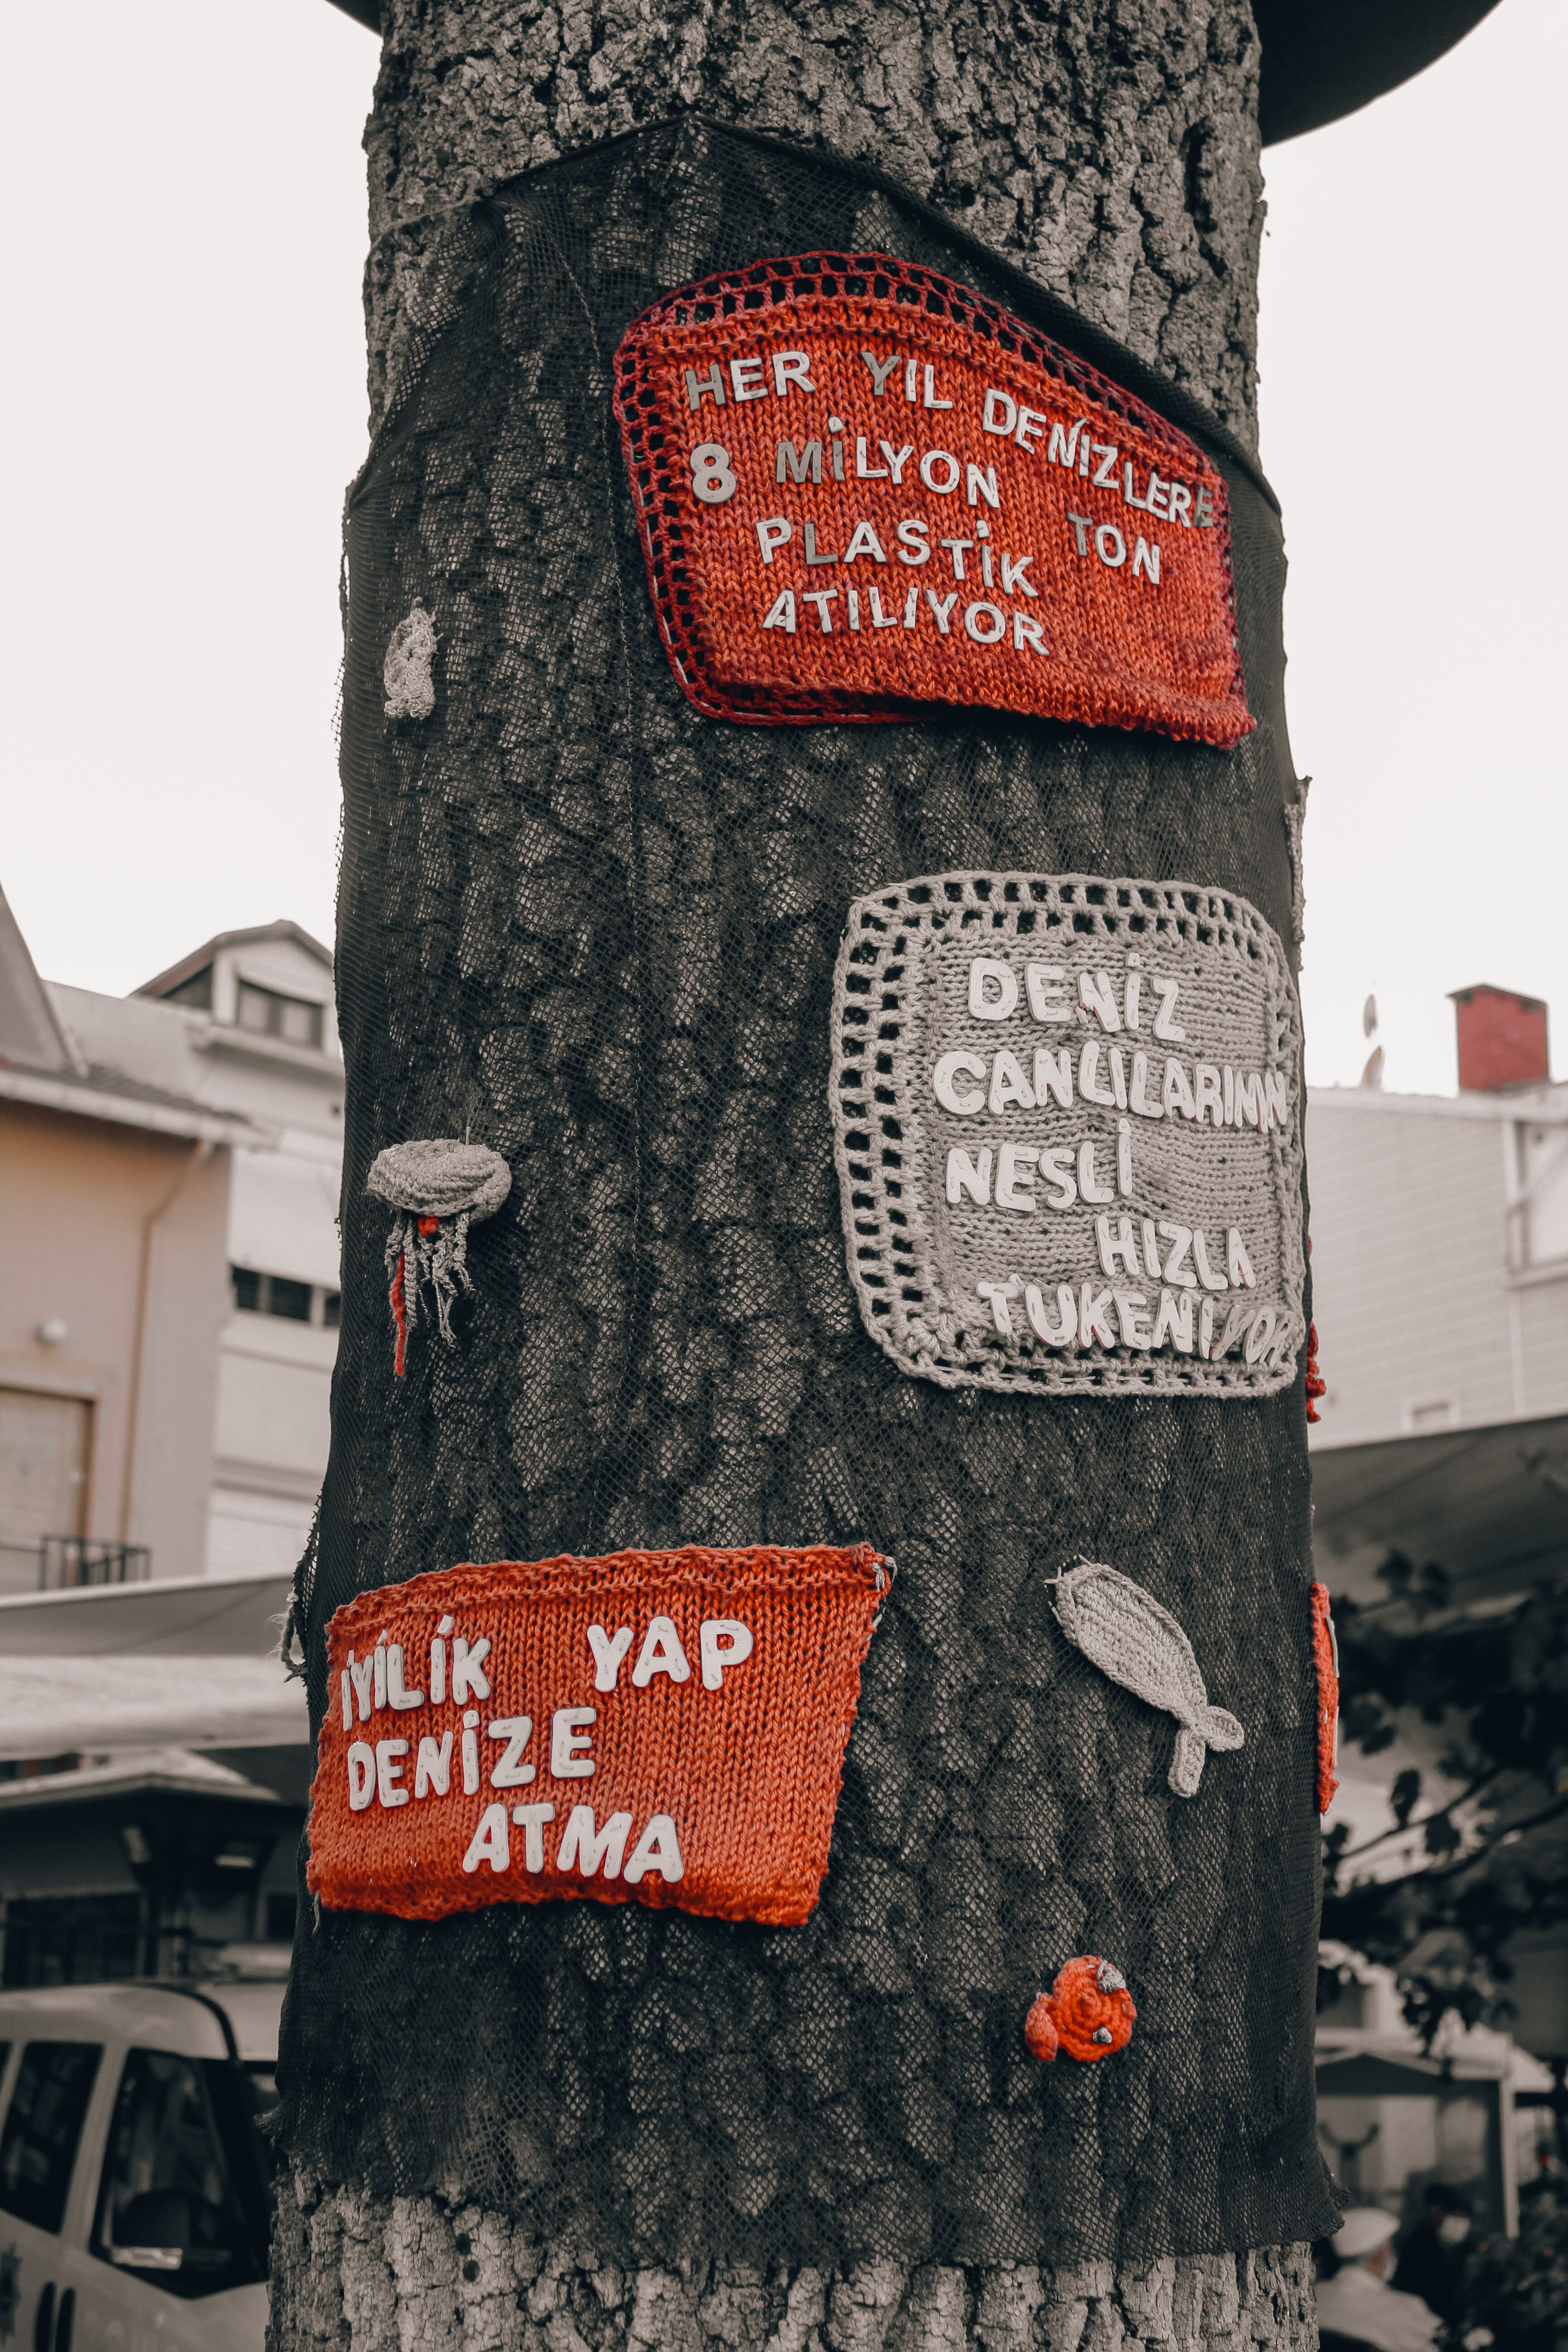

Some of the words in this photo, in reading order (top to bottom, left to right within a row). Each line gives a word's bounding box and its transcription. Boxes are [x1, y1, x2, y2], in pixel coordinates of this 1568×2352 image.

[686, 350, 817, 410] HER
[861, 351, 953, 410] YIL
[982, 388, 1214, 528] DENİZLERE
[690, 443, 737, 504] 8
[1066, 512, 1161, 584] TON
[755, 517, 1039, 598] PLASTİK
[762, 587, 1049, 656] ATILIYOR
[968, 953, 1186, 1042] DENİZ
[946, 1118, 1133, 1212] NESLİ
[1095, 1216, 1257, 1290] HIZLA
[341, 1614, 490, 1731] İYİLİK
[587, 1616, 754, 1692] YAP
[347, 1706, 598, 1811] DENİZE
[462, 1802, 685, 1884] ATMA
